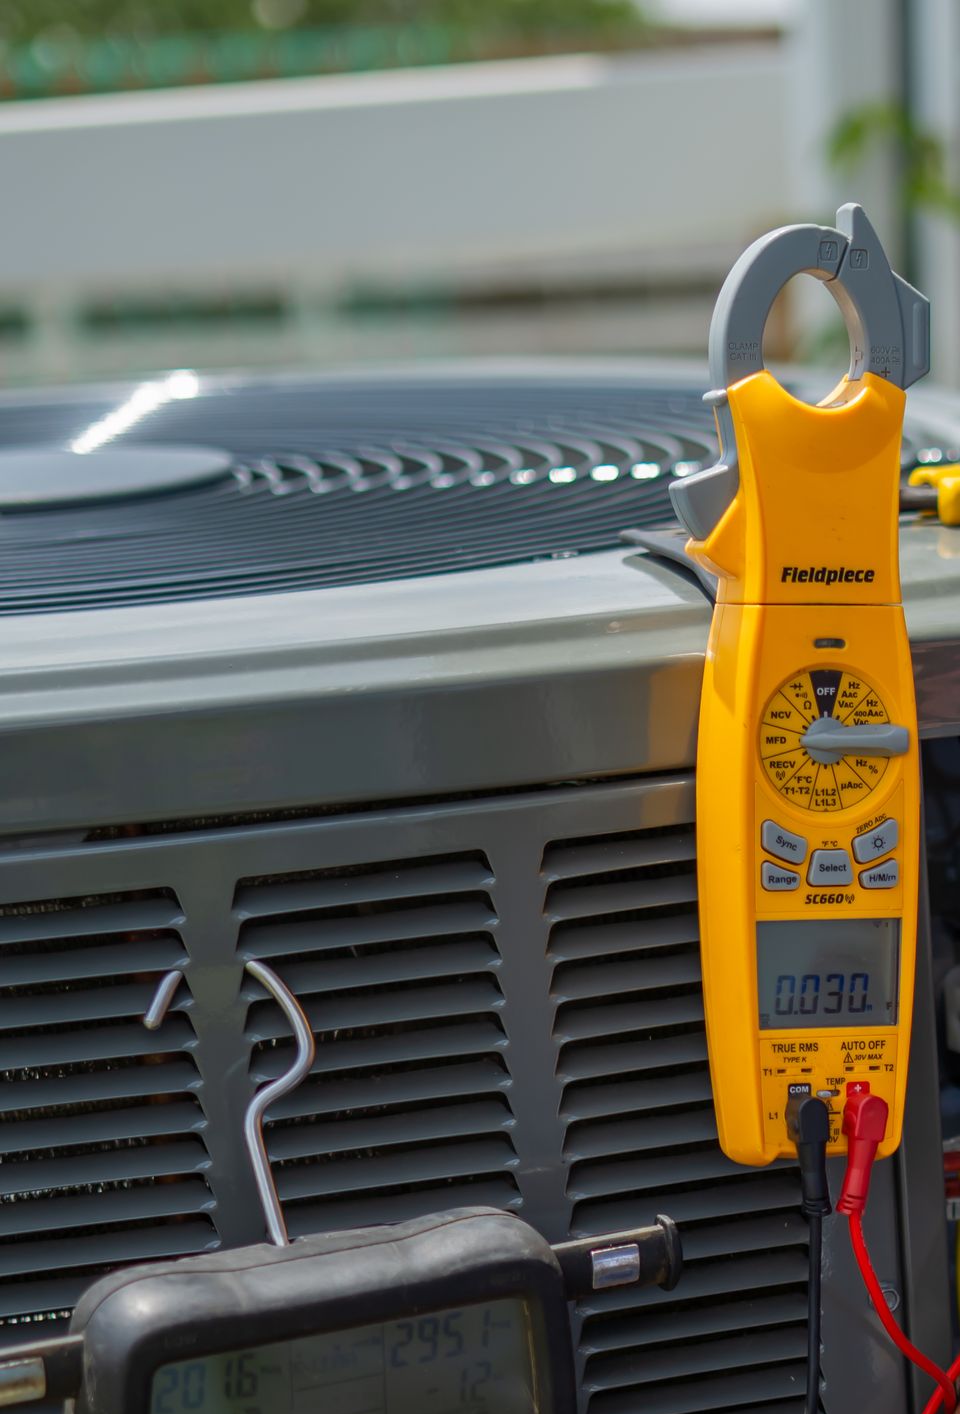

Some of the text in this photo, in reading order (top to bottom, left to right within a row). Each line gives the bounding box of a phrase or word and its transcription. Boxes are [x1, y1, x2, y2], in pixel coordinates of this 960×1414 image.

[781, 567, 875, 585] Fieldpiece
[848, 682, 860, 690] Hz
[816, 687, 836, 696] OFF
[771, 711, 791, 719] NCV
[769, 761, 796, 769] RECV
[855, 759, 868, 767] Hz
[784, 787, 810, 795] T1-T2
[815, 788, 837, 796] L1L2
[815, 798, 837, 807] L1L3
[856, 820, 873, 834] ZERO
[776, 835, 797, 851] Sync
[819, 863, 846, 872] Select
[768, 875, 797, 885] Range
[805, 894, 844, 905] SC660
[772, 1042, 819, 1054] TRUE RMS
[841, 1040, 886, 1051] AUTO OFF
[884, 1064, 894, 1072] T2
[826, 1077, 846, 1086] TEMP
[789, 1085, 809, 1093] COM
[769, 1112, 778, 1120] L1
